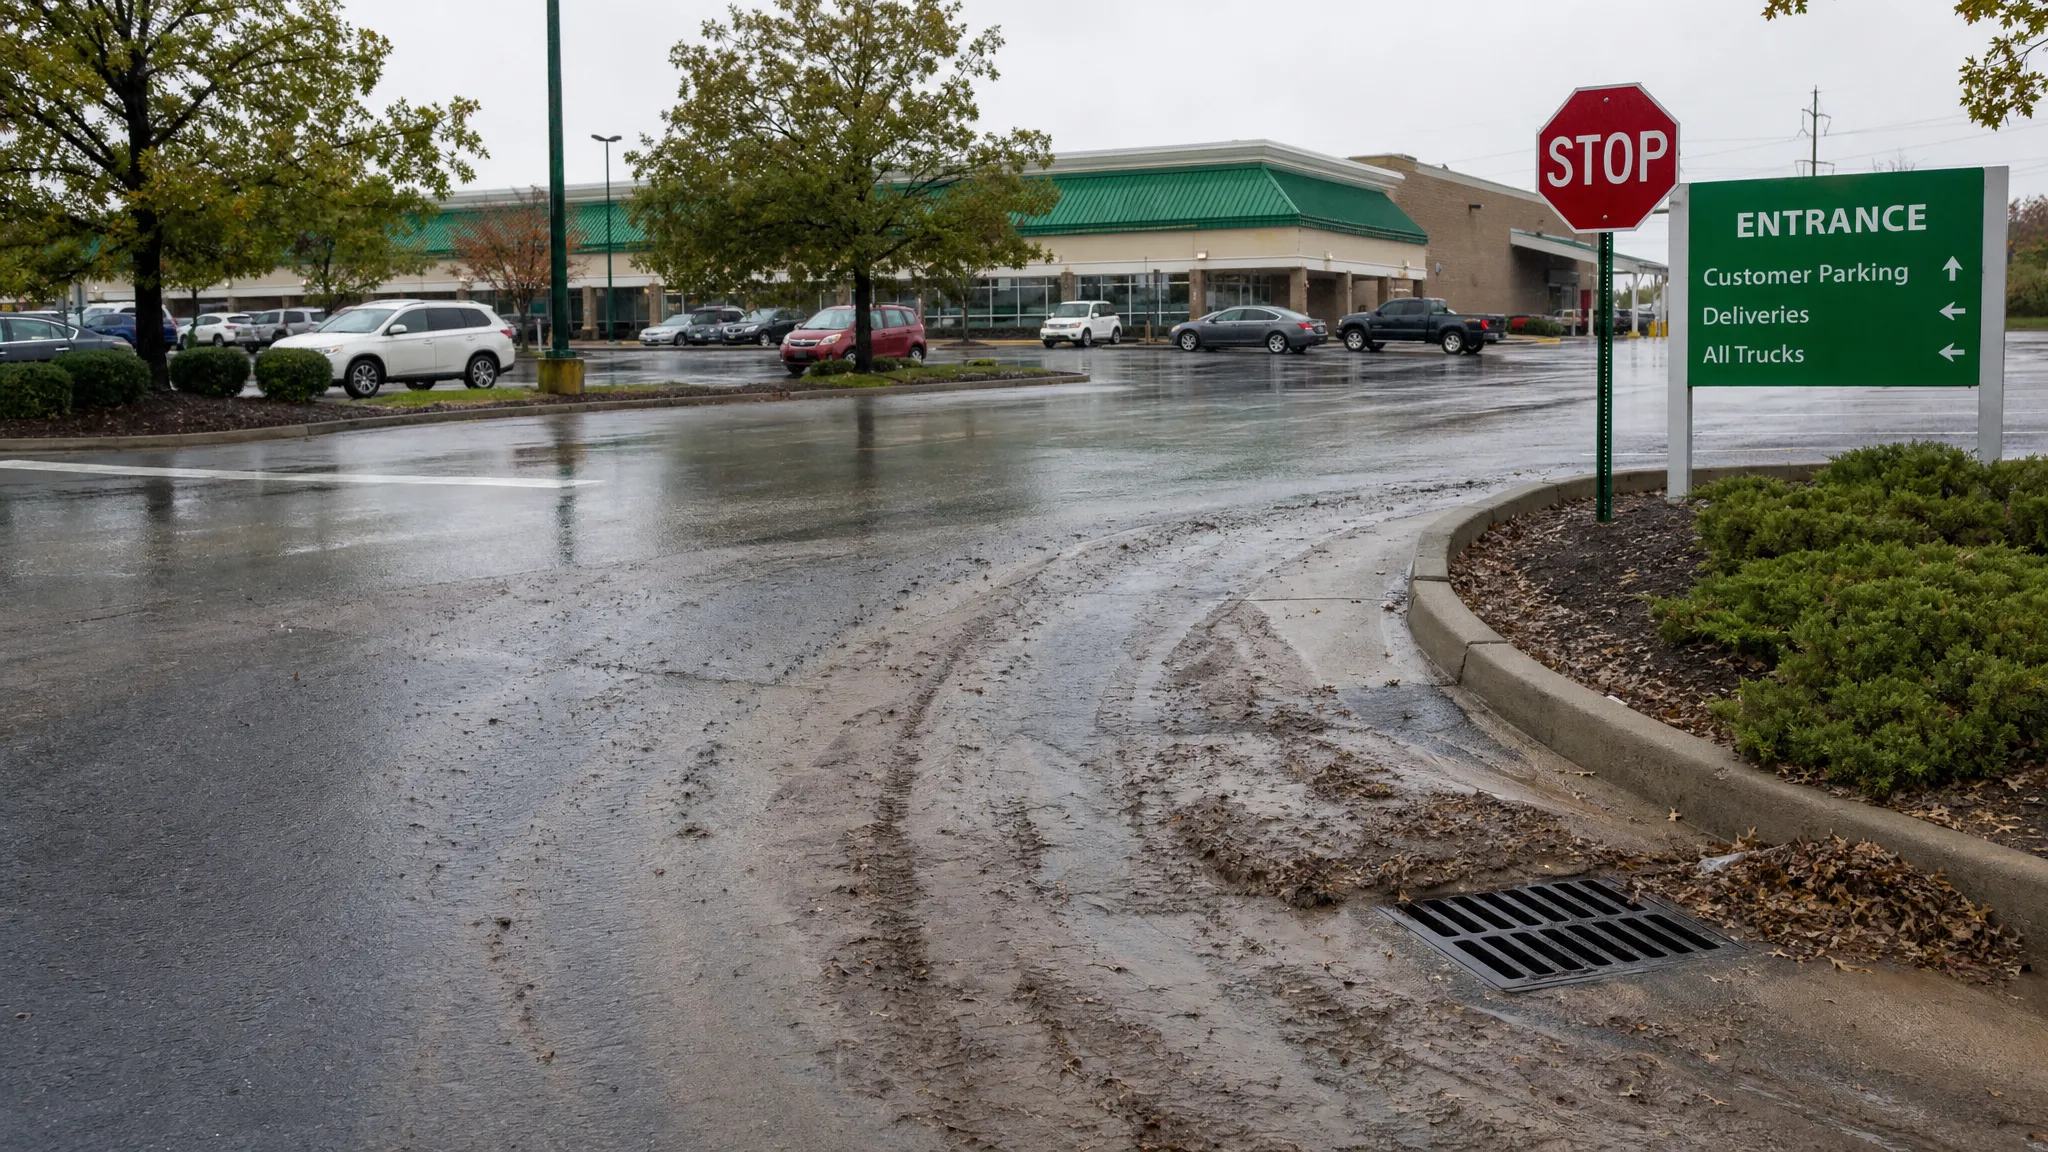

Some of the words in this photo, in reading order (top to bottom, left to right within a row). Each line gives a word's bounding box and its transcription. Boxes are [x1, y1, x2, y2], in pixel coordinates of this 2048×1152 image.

[1547, 130, 1668, 188] STOP
[1737, 204, 1927, 238] ENTRANCE
[1703, 267, 1812, 286] Customer
[1819, 263, 1909, 286] Parking
[1703, 305, 1810, 325] Deliveries
[1703, 346, 1730, 364] All
[1734, 344, 1805, 364] Trucks
